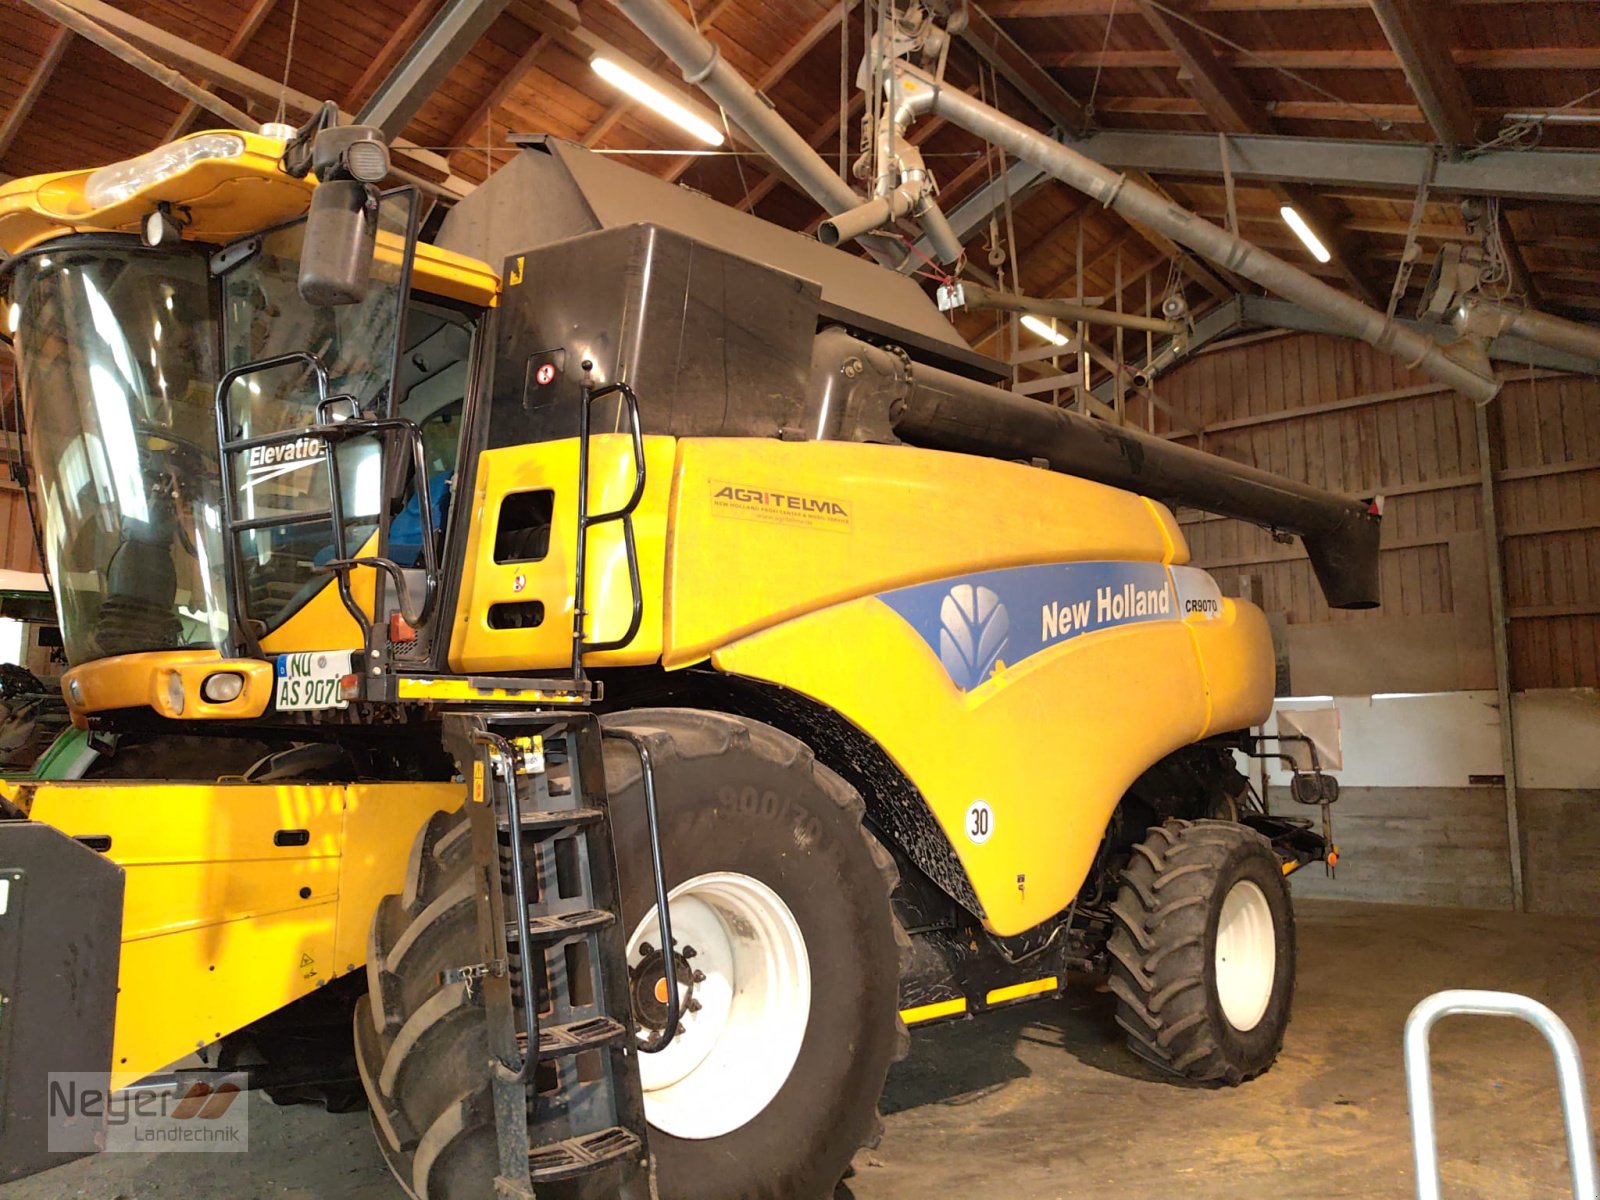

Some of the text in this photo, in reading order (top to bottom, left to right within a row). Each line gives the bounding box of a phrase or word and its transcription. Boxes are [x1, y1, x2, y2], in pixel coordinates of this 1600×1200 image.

[250, 437, 325, 467] Elevatio
[714, 486, 848, 517] AGRITELMA
[1042, 581, 1170, 642] New Holland
[1185, 599, 1218, 613] CR9070
[291, 653, 312, 677] NU
[280, 680, 300, 706] AS
[971, 808, 988, 836] 30
